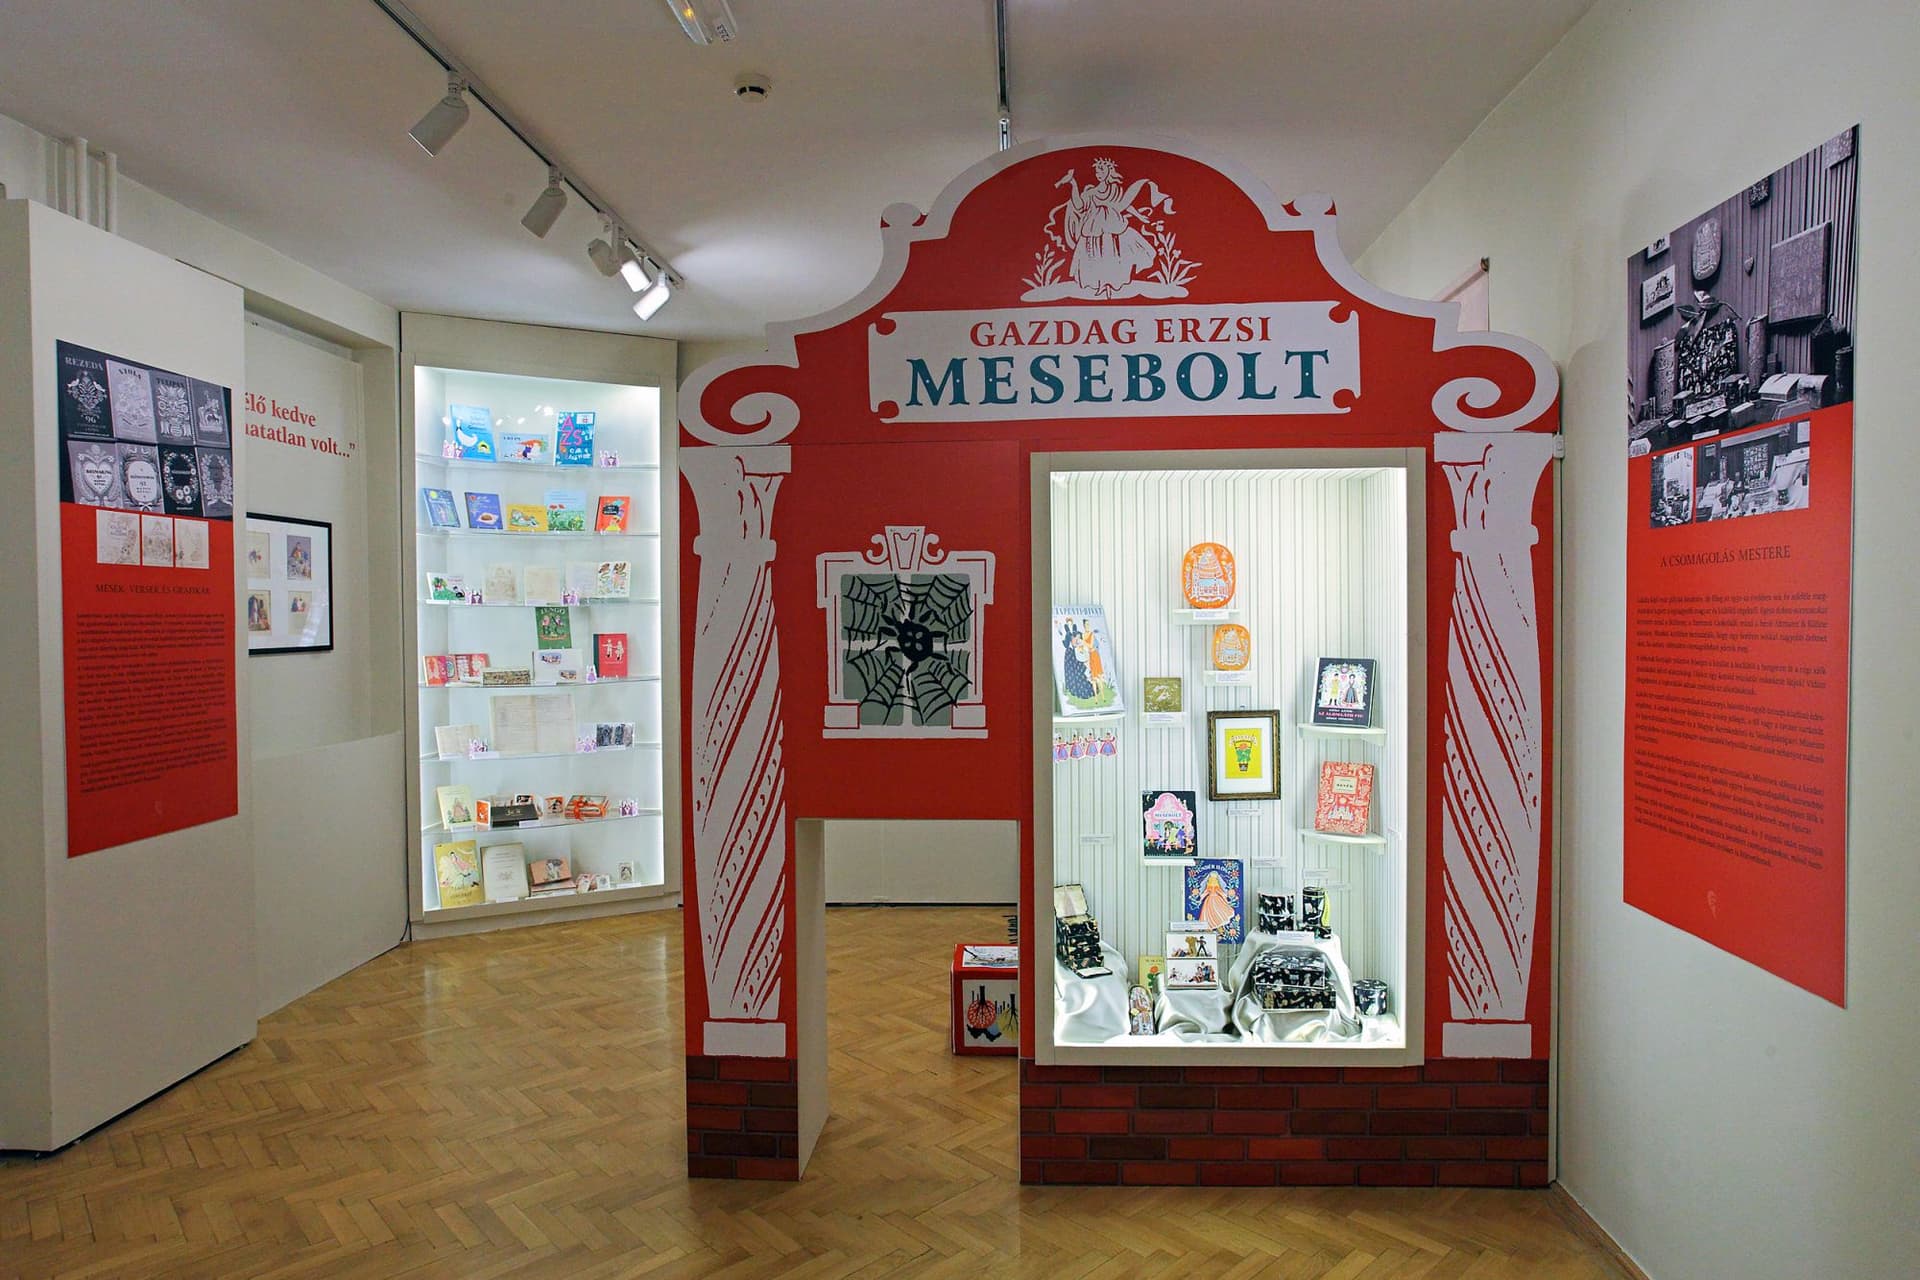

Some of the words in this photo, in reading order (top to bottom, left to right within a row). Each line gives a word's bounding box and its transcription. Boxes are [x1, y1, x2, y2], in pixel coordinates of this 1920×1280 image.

[970, 318, 1137, 347] GAZDAG
[1155, 316, 1271, 343] ERZSI
[905, 349, 1330, 407] MESEBOLT
[271, 399, 317, 427] kedve
[1669, 550, 1735, 567] CSOMAGOLÁS
[1739, 545, 1791, 561] MESTERE
